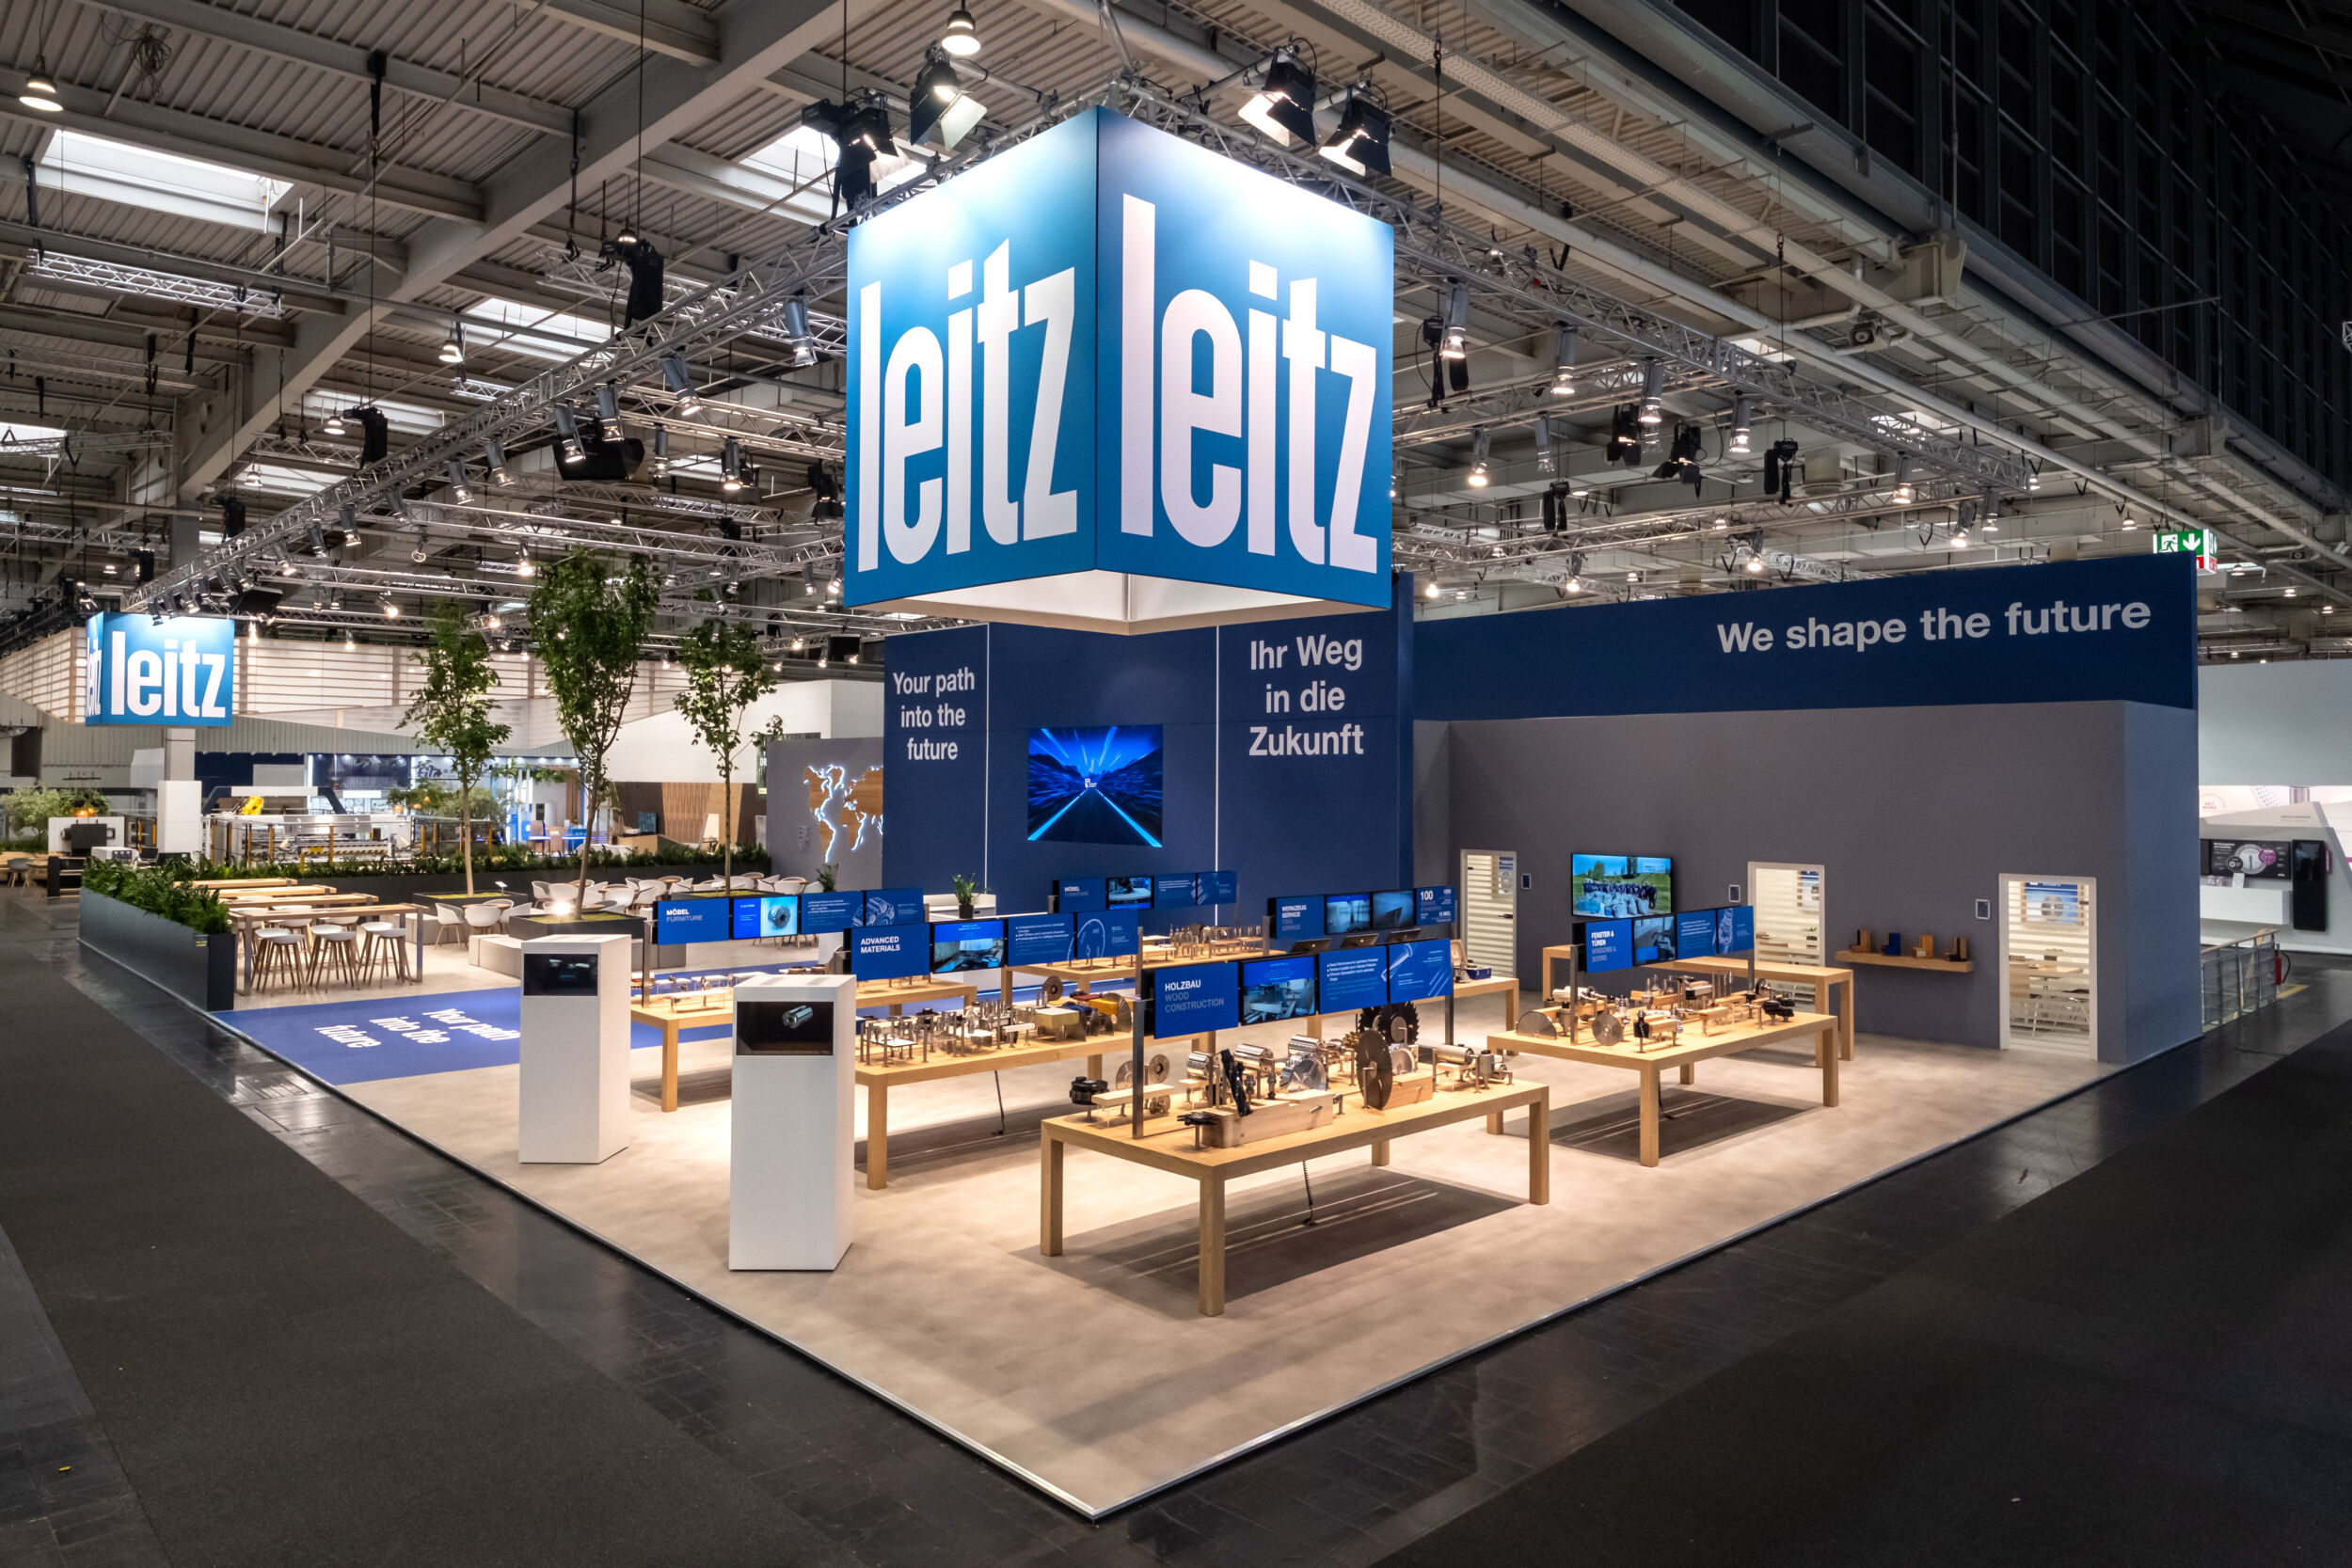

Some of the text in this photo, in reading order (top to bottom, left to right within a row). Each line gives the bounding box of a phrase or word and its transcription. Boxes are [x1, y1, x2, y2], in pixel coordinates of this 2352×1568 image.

[1120, 193, 1377, 574] leitz
[858, 238, 1077, 572] leitz
[1717, 600, 2152, 653] We shape the future
[1250, 634, 1362, 672] Ihr Weg
[111, 631, 226, 718] leitz
[893, 666, 976, 698] Your path
[1265, 680, 1345, 713] in die
[901, 703, 966, 728] into the
[907, 737, 958, 760] future
[1249, 723, 1364, 756] Zukunft
[1420, 890, 1434, 901] 100
[666, 908, 690, 916] MÖBEL
[666, 914, 704, 923] FURNITURE
[860, 936, 899, 945] ADVANCED
[860, 943, 900, 955] MATERIALS
[1165, 979, 1201, 992] HOLZBAU
[1165, 991, 1189, 1002] WOOD
[1165, 998, 1224, 1013] CONSTRUCTION
[313, 1024, 382, 1048] future
